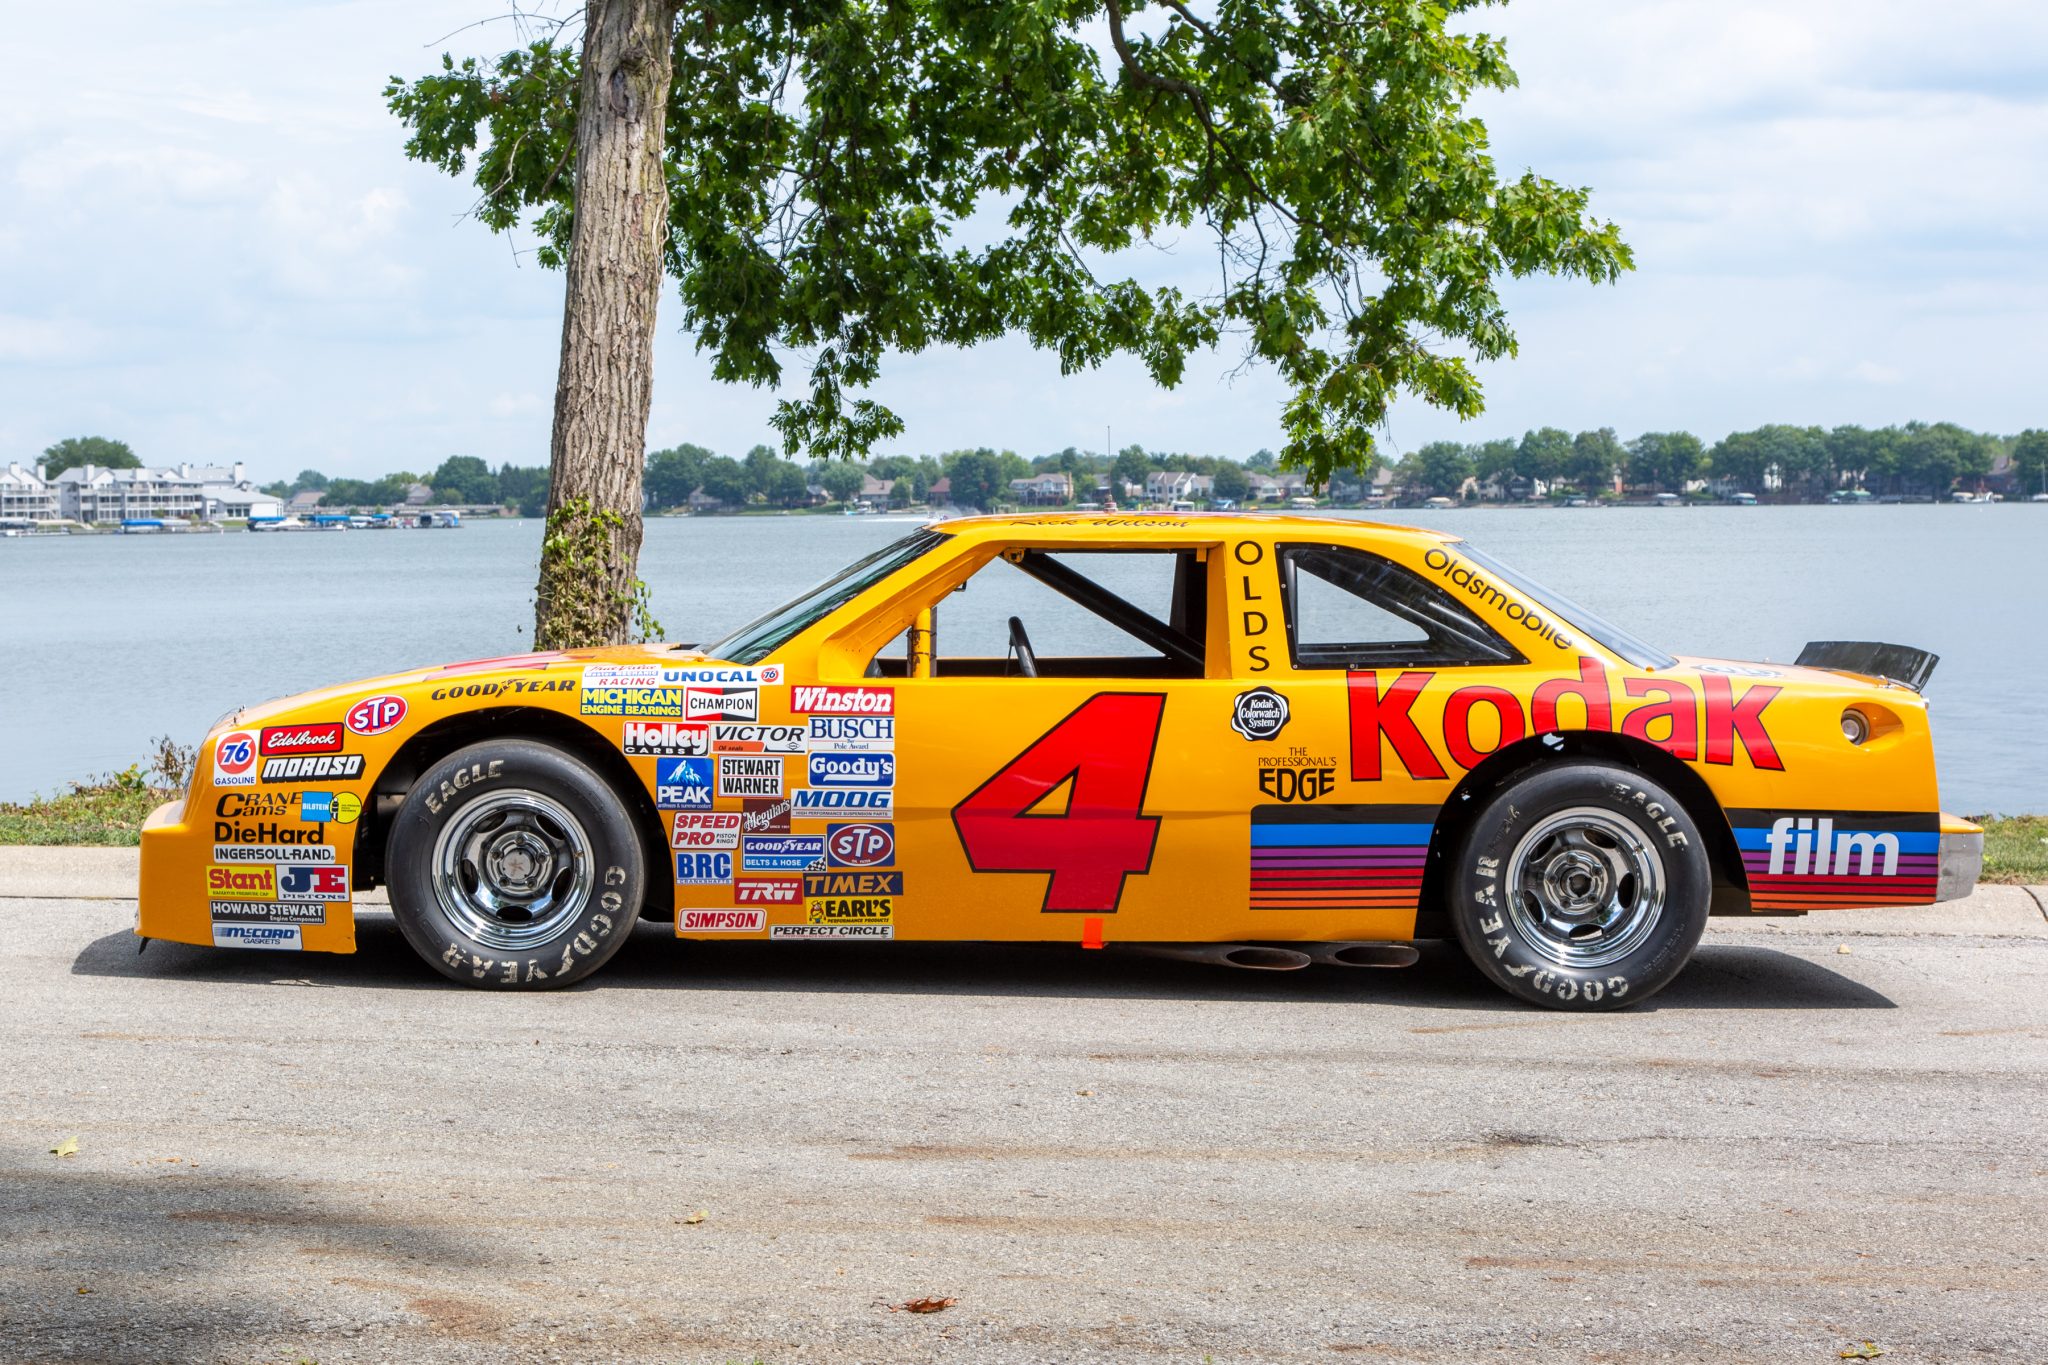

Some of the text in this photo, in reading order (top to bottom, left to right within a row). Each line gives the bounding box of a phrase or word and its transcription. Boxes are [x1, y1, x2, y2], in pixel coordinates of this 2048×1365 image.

[1089, 519, 1191, 527] Wilson
[1235, 540, 1270, 672] OLDS
[1424, 548, 1573, 650] Oldsmobile
[599, 677, 656, 686] RACING
[664, 670, 757, 683] UNOCAL
[763, 670, 776, 680] 76
[431, 679, 576, 701] GOODYEAR
[582, 688, 681, 705] MICHIGAN
[690, 698, 753, 710] CHAMPION
[794, 687, 892, 712] Winston
[1250, 699, 1274, 709] Kodak
[353, 697, 400, 729] STP
[582, 705, 681, 716] ENGINE BEARINGS
[1240, 708, 1280, 719] Colorwatch
[1248, 718, 1275, 728] System
[1346, 656, 1786, 783] Kodak
[715, 726, 805, 741] VICTOR
[809, 718, 893, 739] BUSCH
[267, 730, 336, 748] Edelbrock
[625, 723, 708, 755] Holley
[222, 740, 251, 763] 76
[625, 746, 686, 754] CARBS
[1289, 747, 1308, 756] THE
[262, 755, 362, 778] MOROSO
[722, 759, 780, 775] STEWART
[811, 757, 893, 781] Goody's
[1258, 757, 1337, 767] PROFESSIONAL'S
[214, 776, 255, 785] GASOLINE
[424, 760, 504, 815] EAGLE
[723, 778, 778, 794] WARNER
[1259, 768, 1336, 803] EDGE
[658, 786, 711, 803] PEAK
[794, 791, 891, 808] MOOG
[951, 691, 1168, 913] 4
[302, 803, 329, 811] BILSTEIN
[743, 799, 791, 832] Meguiar's
[676, 815, 739, 829] SPEED
[214, 821, 324, 844] DieHard
[675, 832, 715, 845] PRO
[746, 841, 822, 852] GOODYEAR
[837, 829, 884, 857] STP
[1766, 817, 1900, 876] film
[215, 848, 331, 861] INGERSOLL-RAND
[677, 853, 731, 879] BRC
[209, 869, 273, 890] Stant
[280, 867, 346, 893] JE
[805, 875, 894, 894] TIMEX
[738, 882, 799, 900] TRW
[212, 903, 323, 916] HOWARD STEWART
[826, 899, 891, 917] EARL'S
[442, 865, 626, 983] GOODYEAR
[684, 912, 760, 928] SIMPSON
[773, 927, 890, 935] PERFECT CIRCLE
